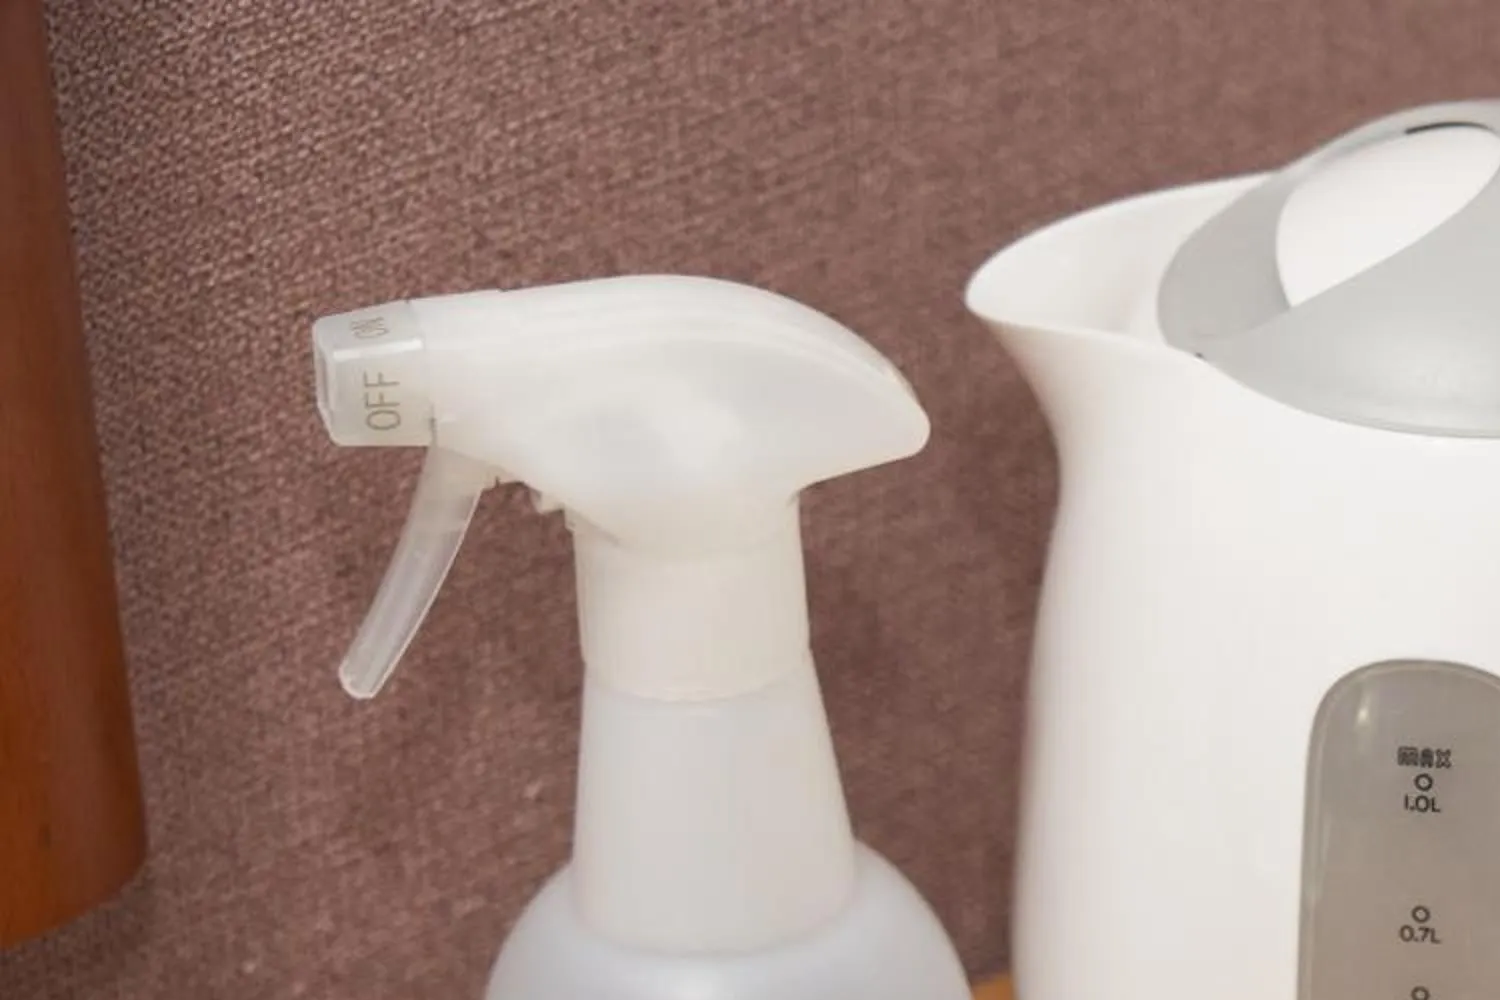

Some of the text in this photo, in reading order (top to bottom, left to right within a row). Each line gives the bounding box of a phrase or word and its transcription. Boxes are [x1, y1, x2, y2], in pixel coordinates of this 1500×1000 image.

[363, 372, 402, 431] OFF
[1404, 794, 1441, 813] 1.0L
[1400, 924, 1441, 944] 0.7L
